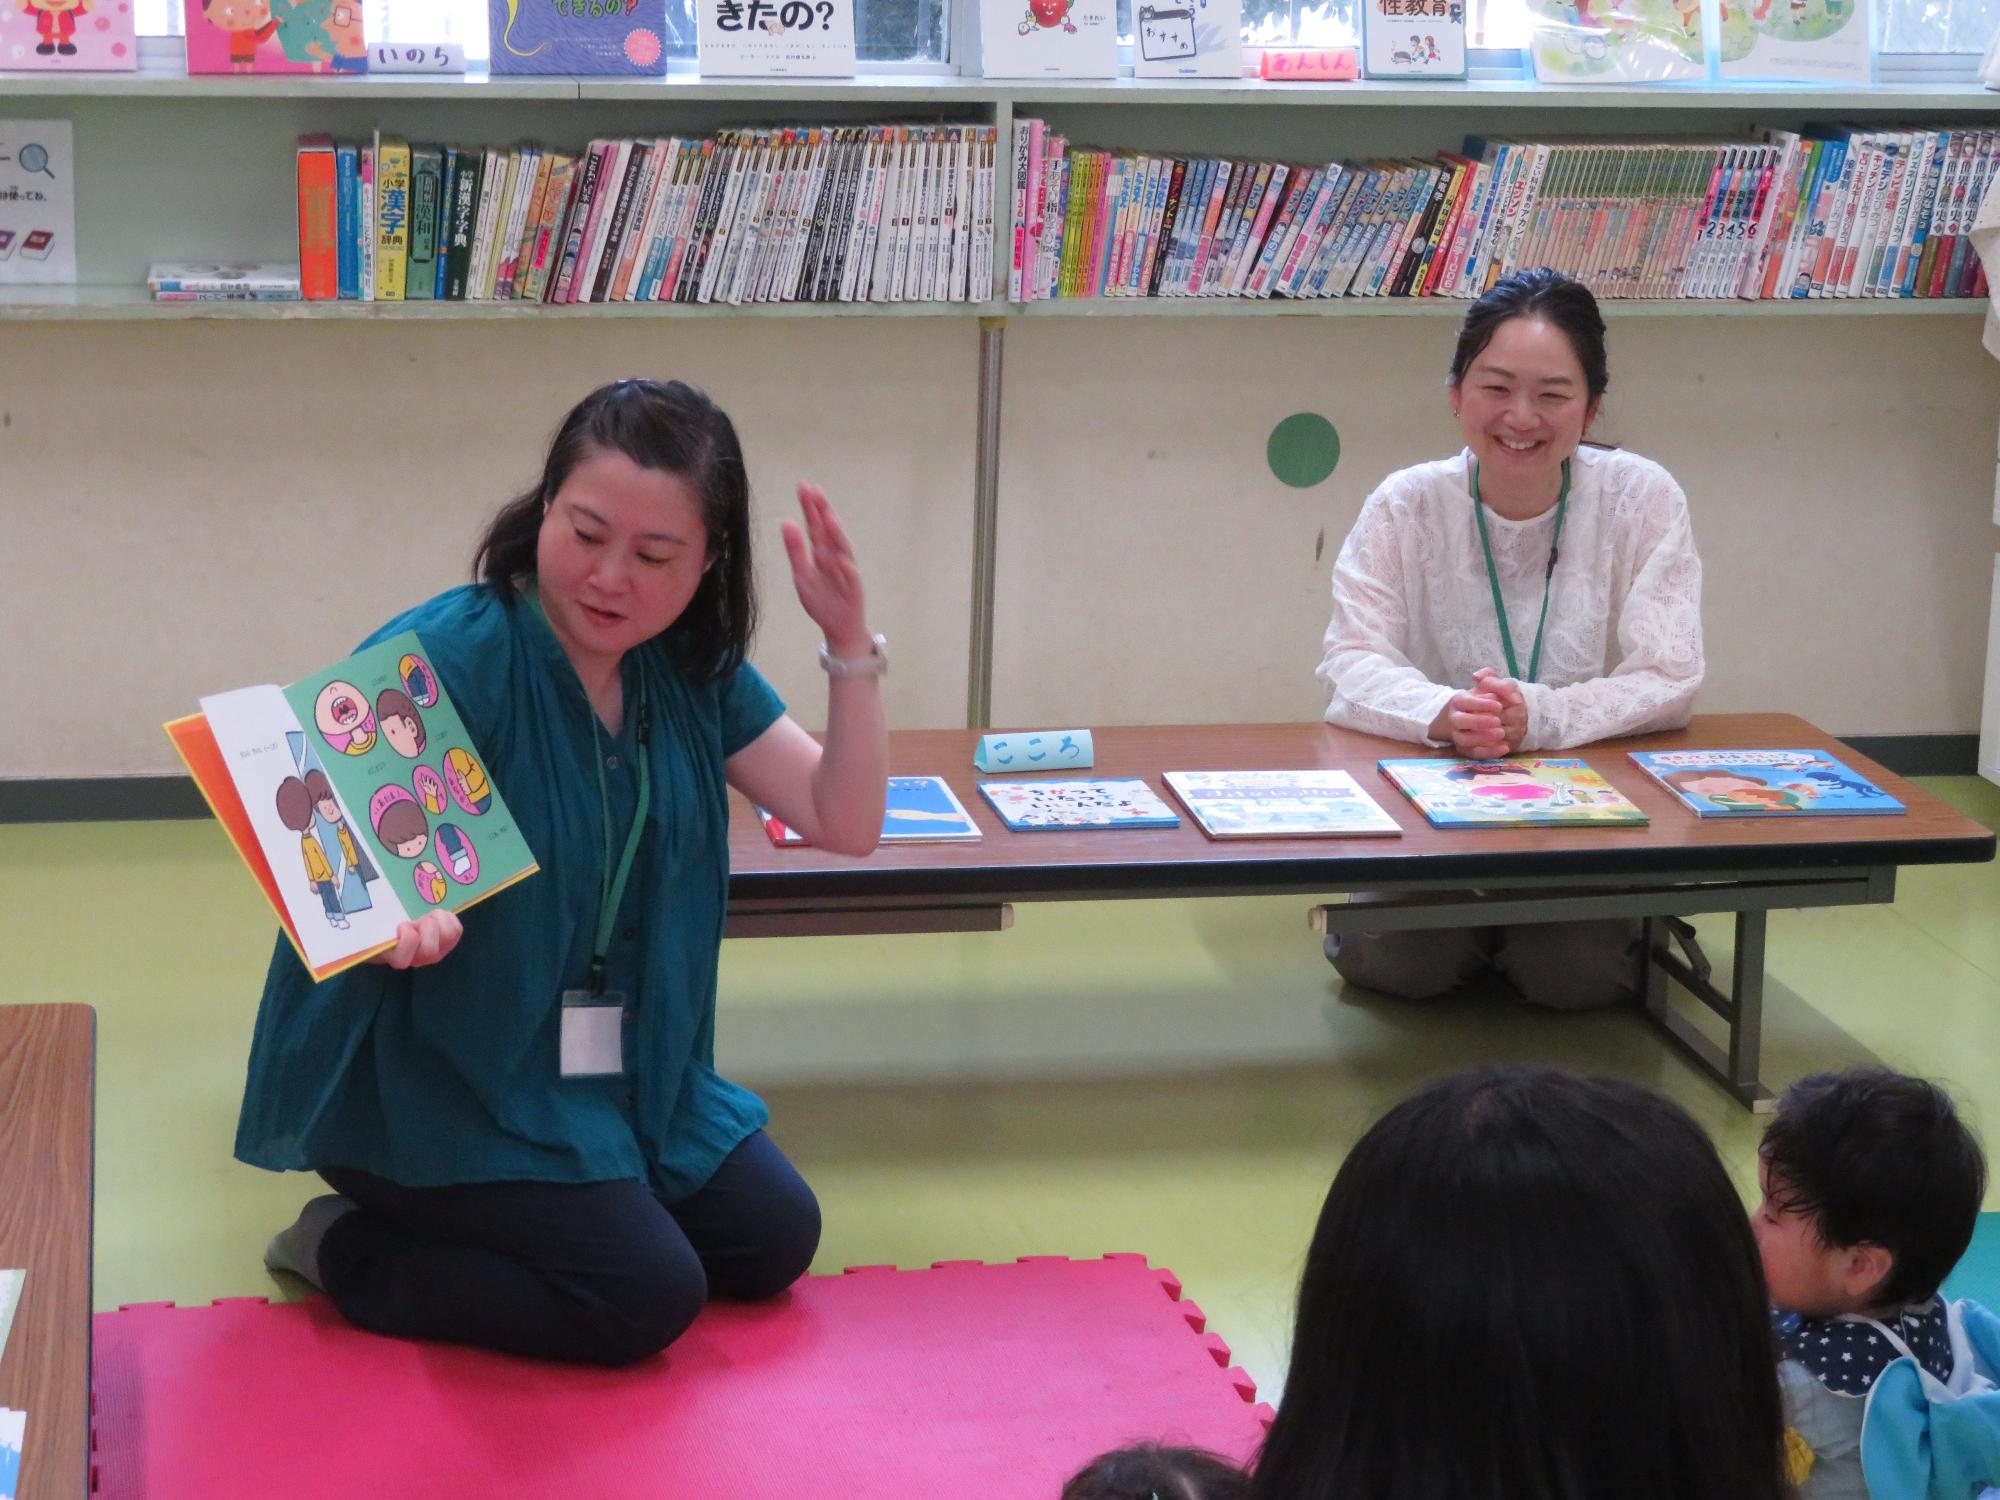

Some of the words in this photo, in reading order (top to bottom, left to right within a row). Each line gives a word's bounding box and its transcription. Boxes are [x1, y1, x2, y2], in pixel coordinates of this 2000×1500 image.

[716, 0, 835, 32] きたの?
[1379, 0, 1446, 17] 性教育
[378, 45, 449, 67] いのち
[1272, 53, 1350, 74] あんしん
[383, 178, 406, 188] 小学
[380, 189, 406, 235] 漢字
[454, 178, 473, 248] 新漢字字典
[1706, 221, 1716, 235] 2
[1719, 222, 1726, 236] 3
[1726, 223, 1736, 236] 4
[1737, 221, 1747, 236] 5
[1748, 222, 1758, 236] 6
[993, 735, 1080, 765] こころ
